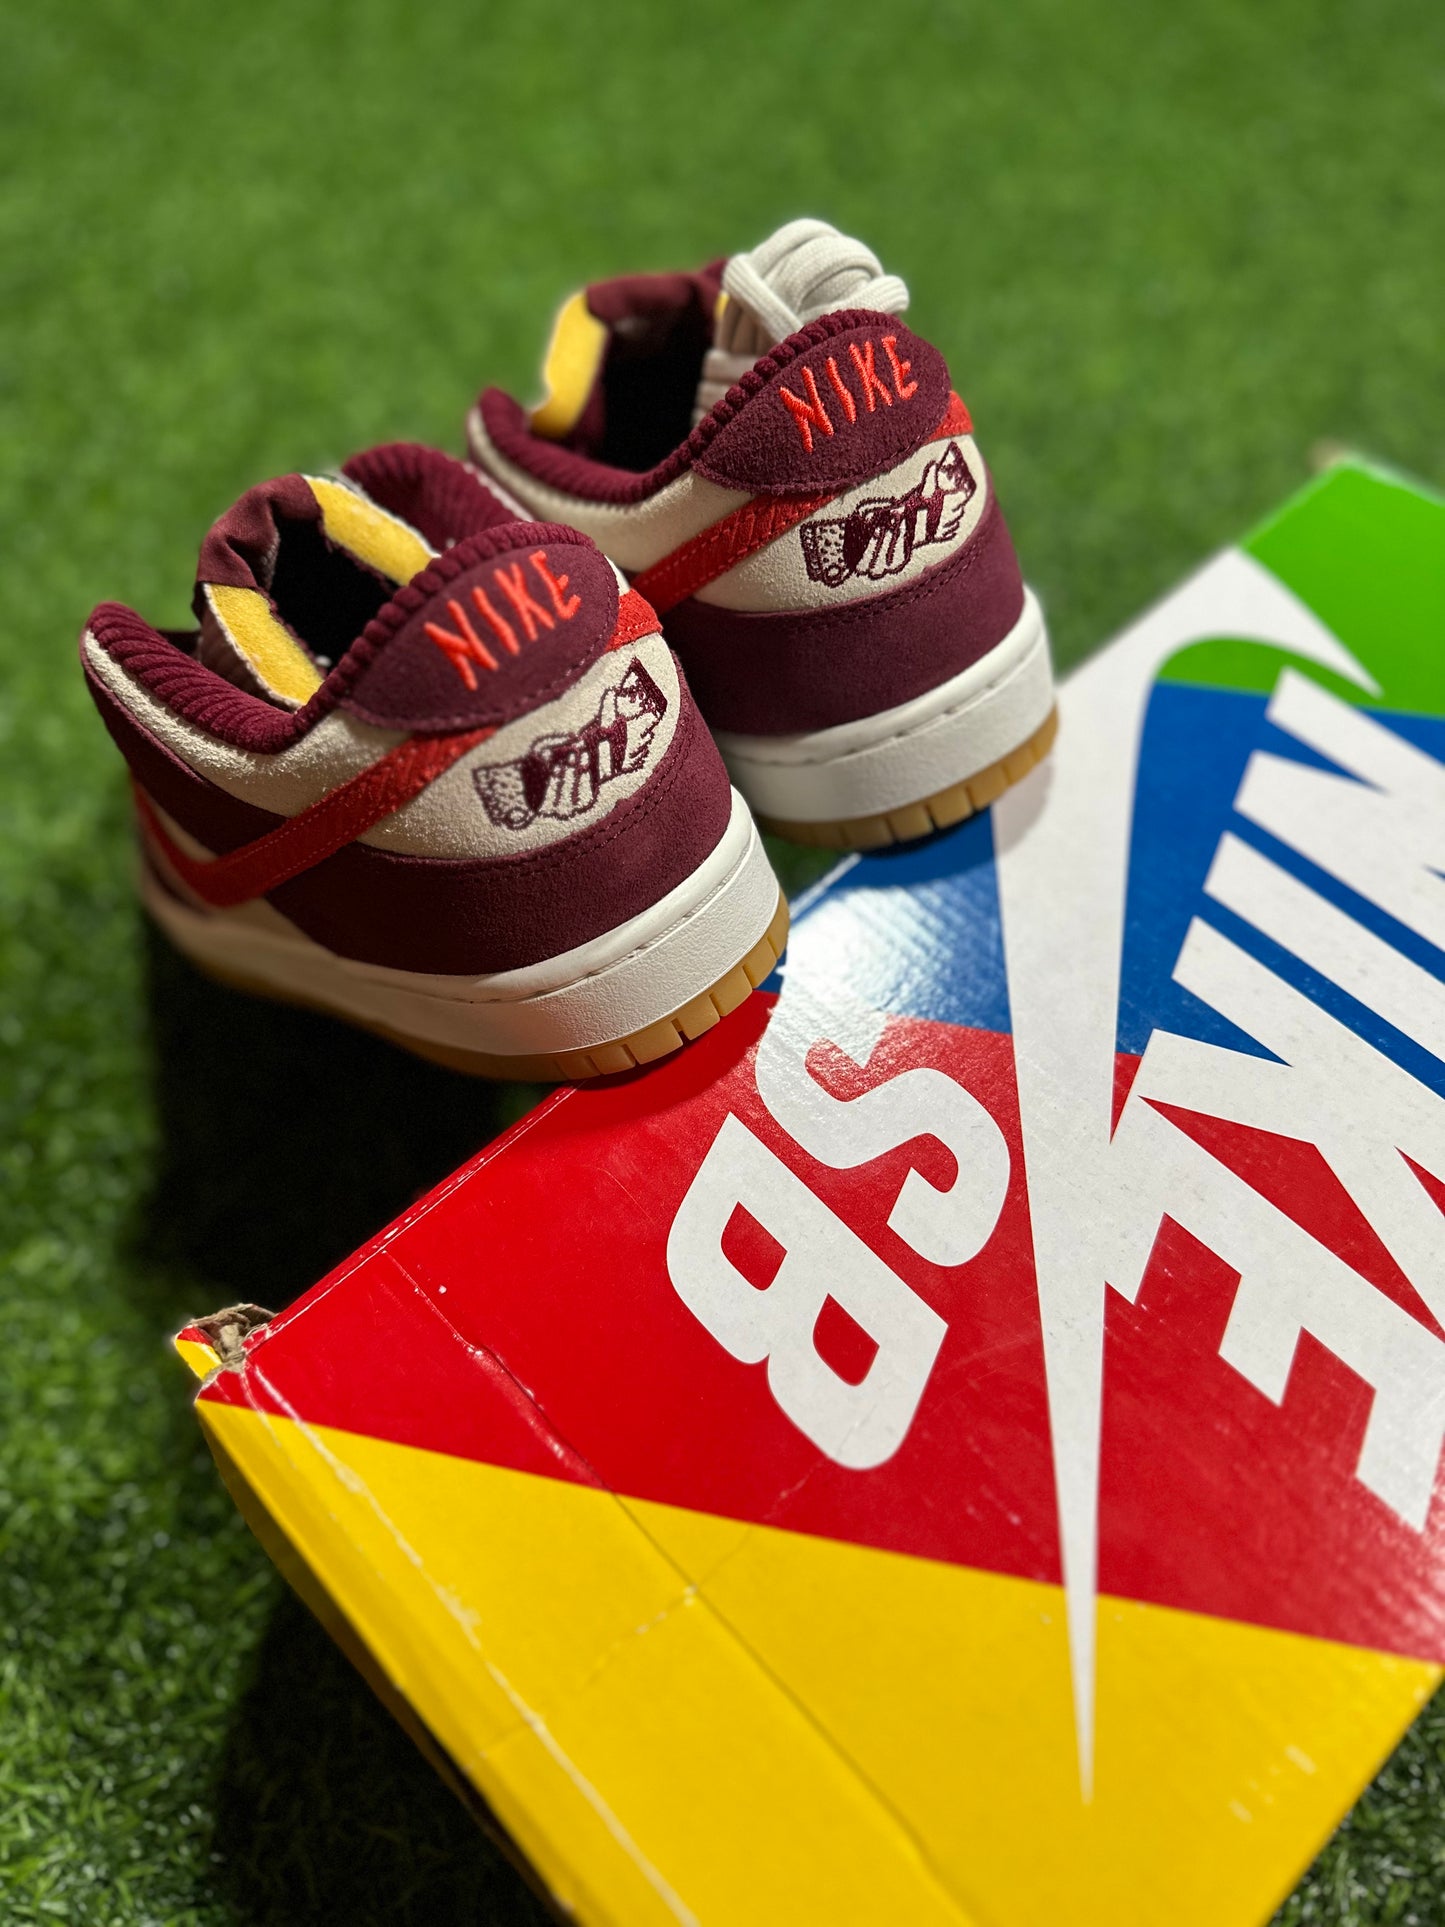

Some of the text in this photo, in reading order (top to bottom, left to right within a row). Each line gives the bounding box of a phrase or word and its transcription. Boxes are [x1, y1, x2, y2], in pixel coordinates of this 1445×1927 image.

[779, 334, 918, 453] NIKE
[423, 549, 582, 690] NIKE
[666, 953, 1011, 1469] SB
